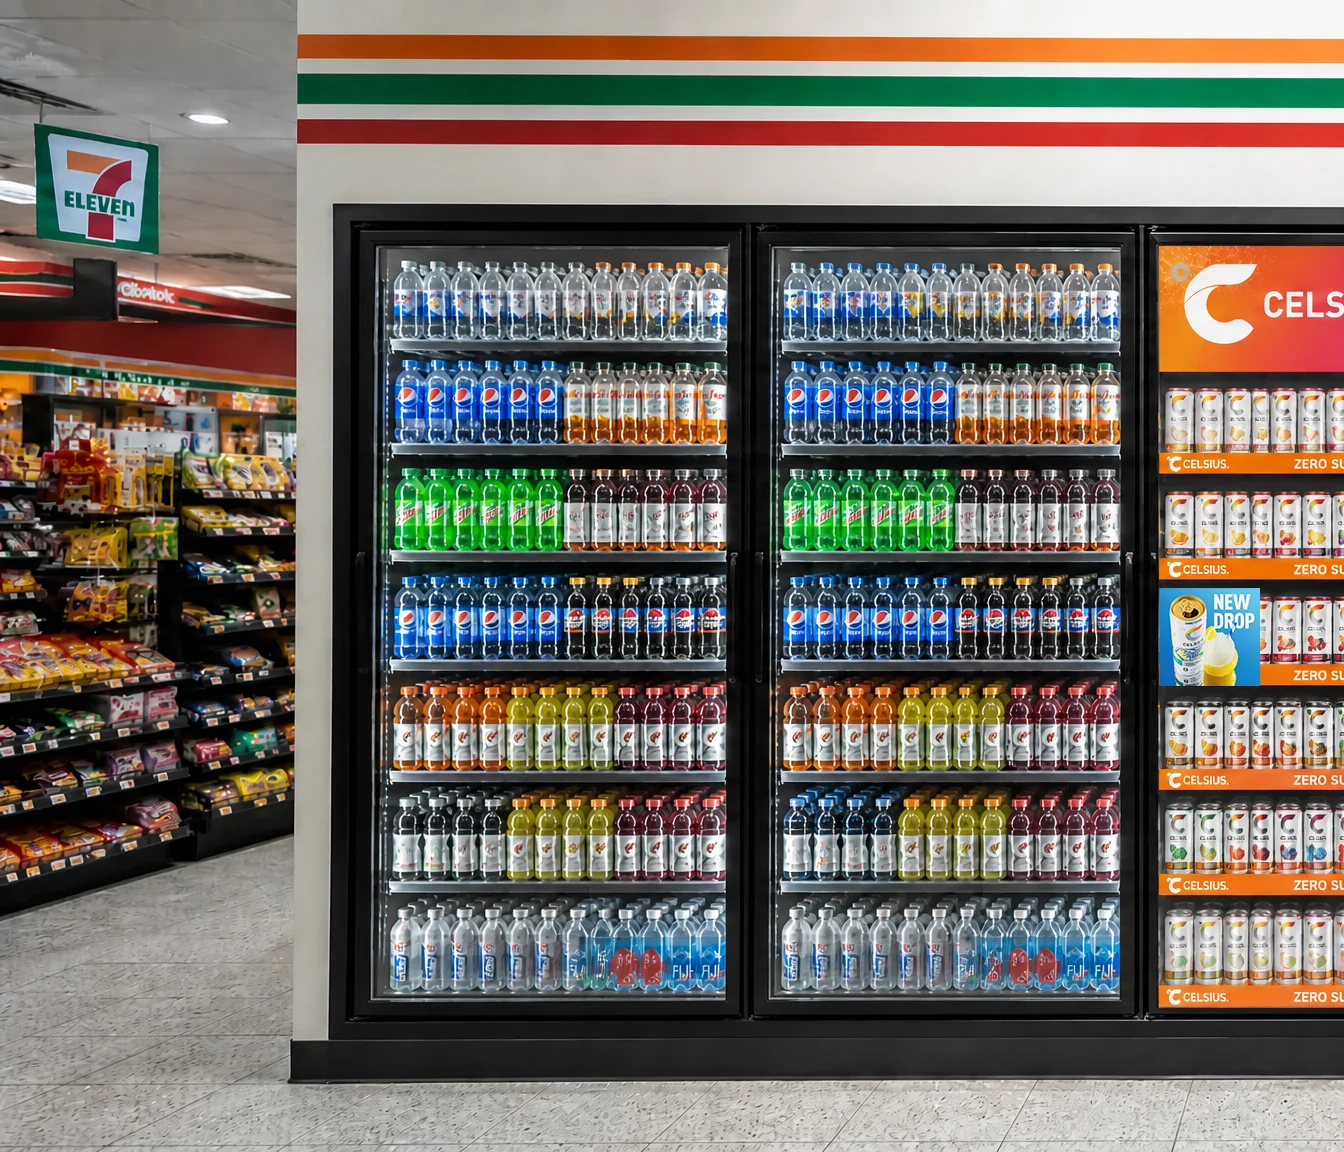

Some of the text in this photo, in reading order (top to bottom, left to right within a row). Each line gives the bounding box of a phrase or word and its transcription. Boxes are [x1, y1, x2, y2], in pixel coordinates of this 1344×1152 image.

[1293, 458, 1327, 470] ZERO
[1293, 564, 1327, 576] ZERO
[1213, 593, 1251, 611] NEW
[1213, 612, 1255, 630] DROP
[1293, 670, 1327, 681] ZERO
[1293, 775, 1327, 786] ZERO
[1293, 880, 1327, 891] ZERO
[1293, 992, 1327, 1003] ZERO
